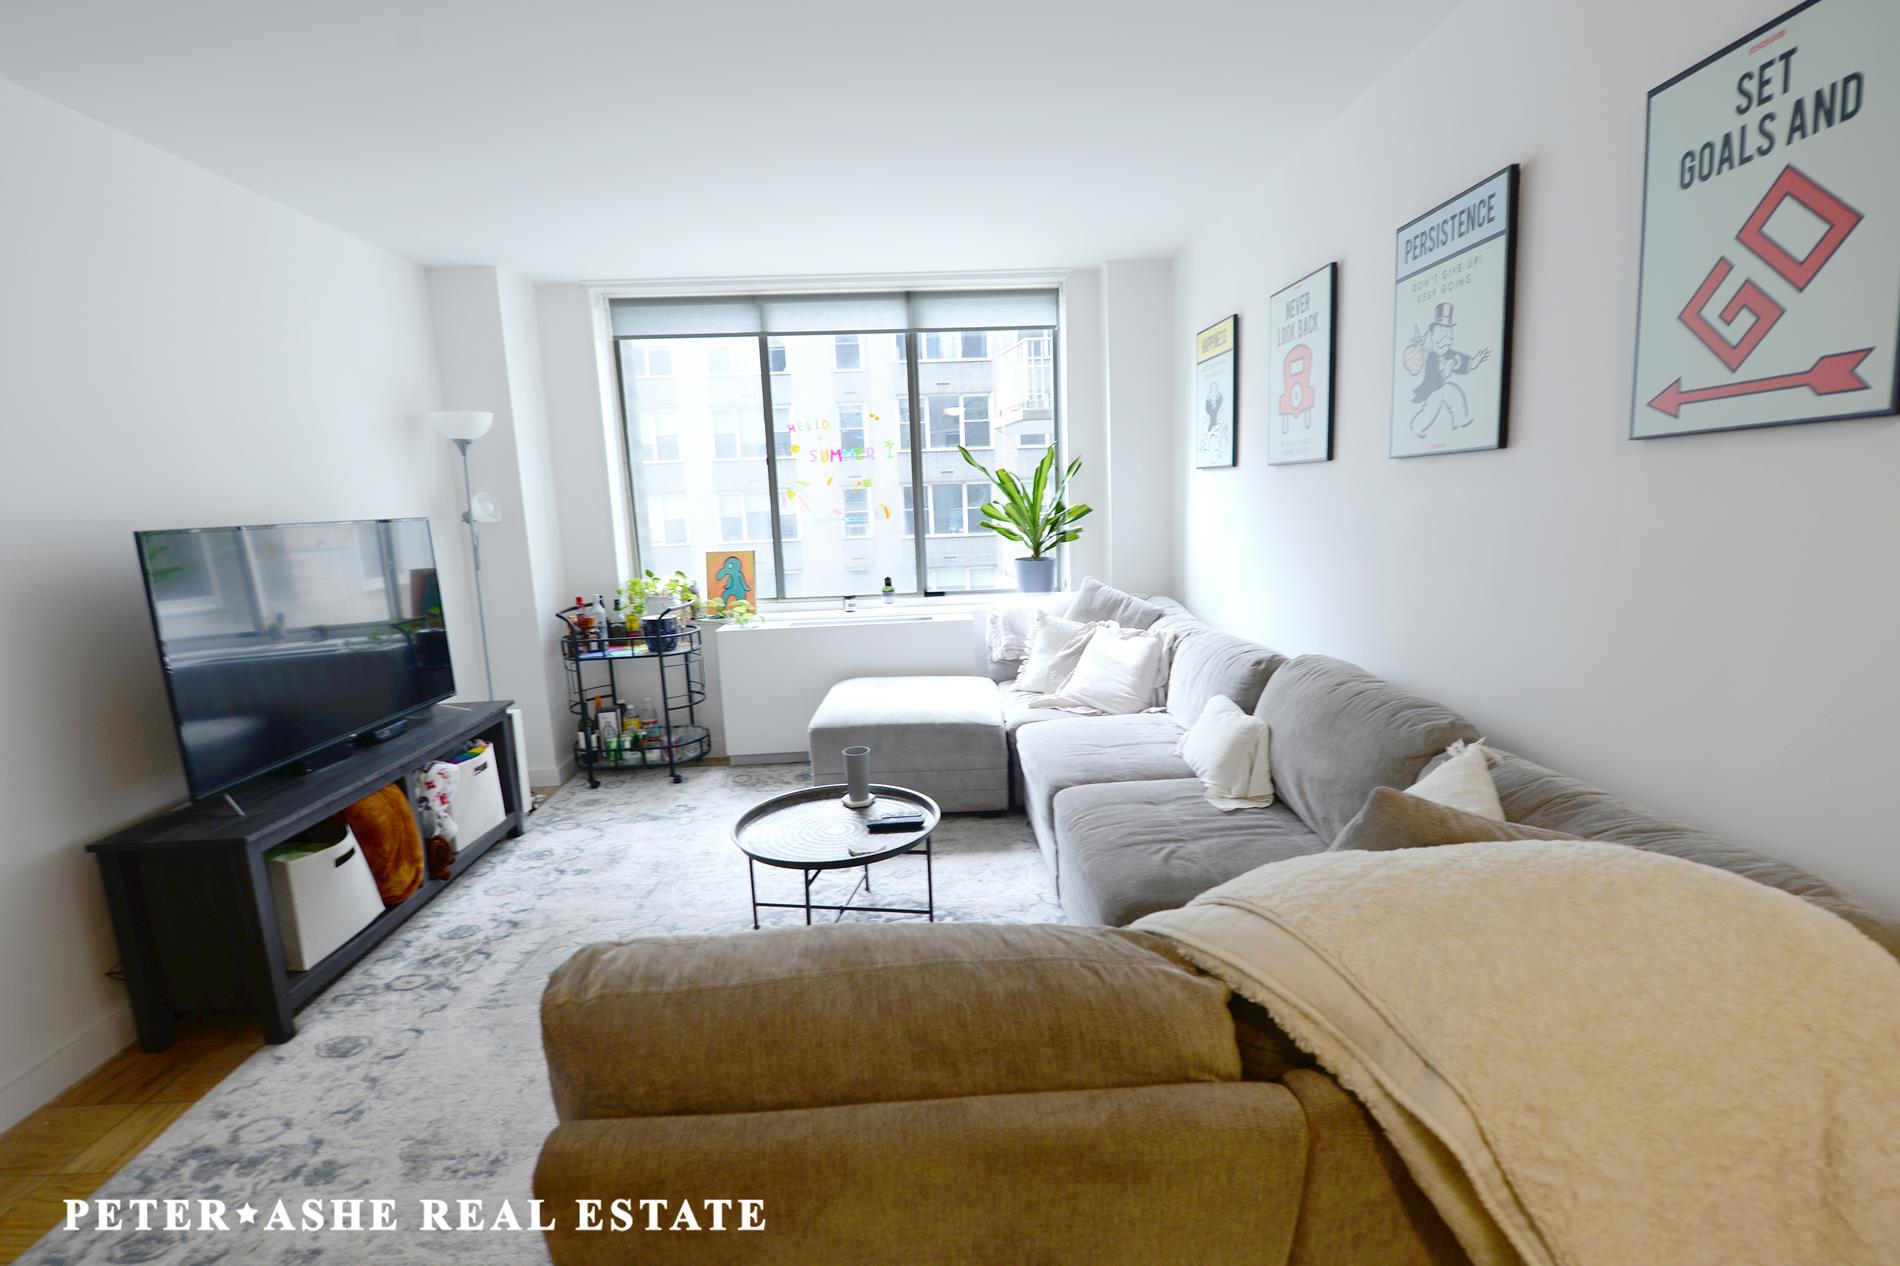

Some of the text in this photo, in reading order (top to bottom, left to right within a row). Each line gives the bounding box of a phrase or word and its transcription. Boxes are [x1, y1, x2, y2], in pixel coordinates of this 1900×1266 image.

[1736, 47, 1798, 116] SET
[1679, 71, 1864, 190] GOALS AND
[1404, 193, 1496, 265] PERSISTENCE
[1678, 163, 1865, 373] GO
[1278, 311, 1319, 347] LOOK BACK
[1286, 291, 1311, 320] NEVER
[787, 419, 829, 432] HELLO
[808, 447, 875, 463] SUMMER
